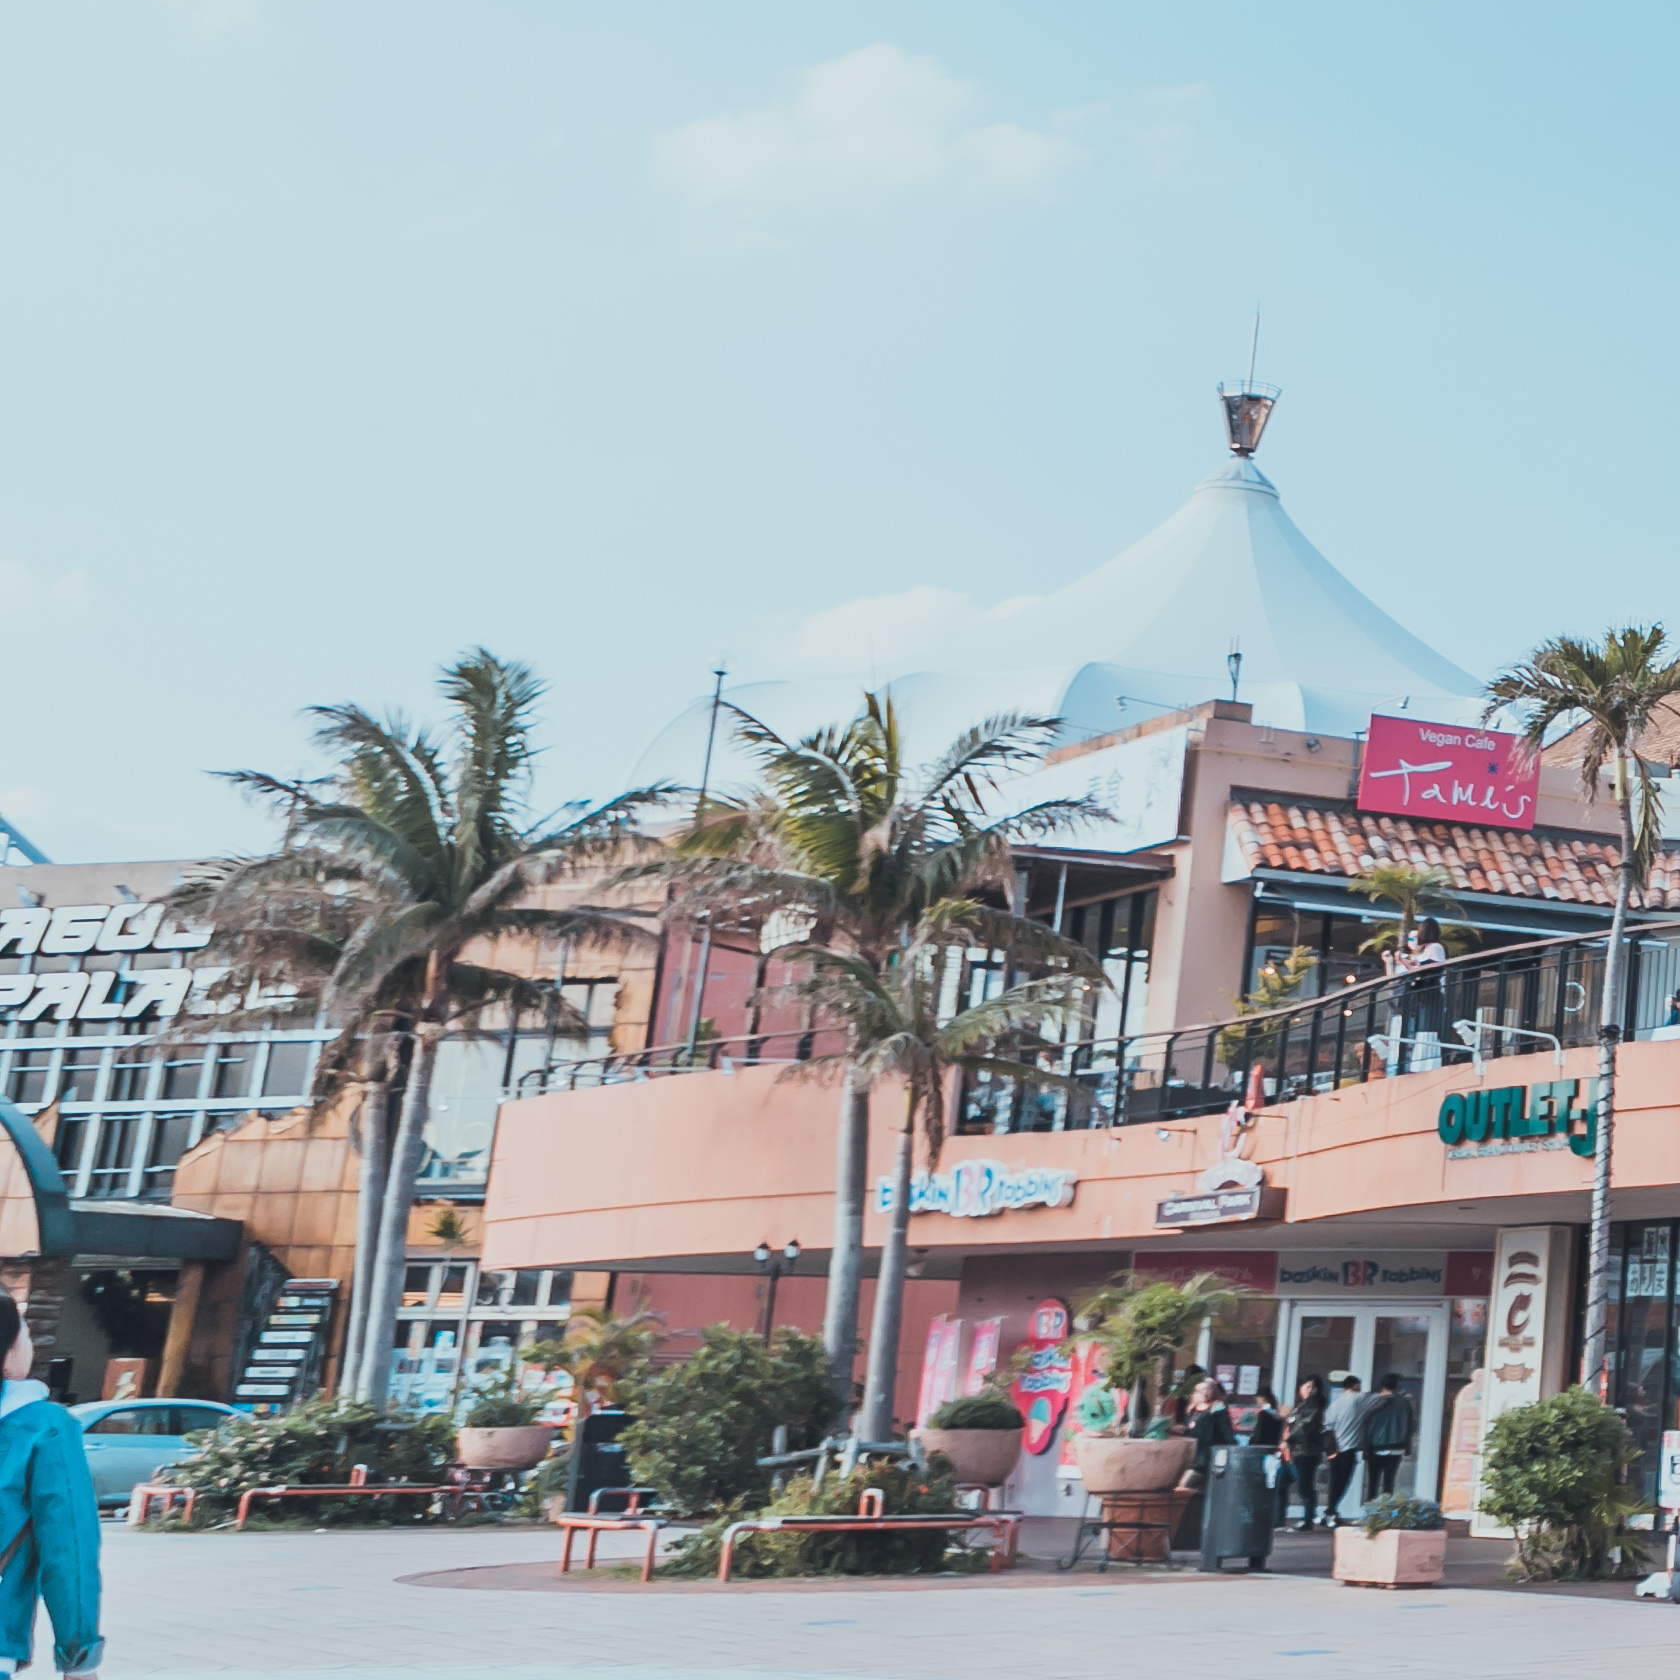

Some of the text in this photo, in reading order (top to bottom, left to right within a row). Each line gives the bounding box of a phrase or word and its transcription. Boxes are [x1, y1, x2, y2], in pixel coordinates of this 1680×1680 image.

[1418, 727, 1497, 751] Vegan Cafe
[1438, 1078, 1601, 1158] OUTLET-J
